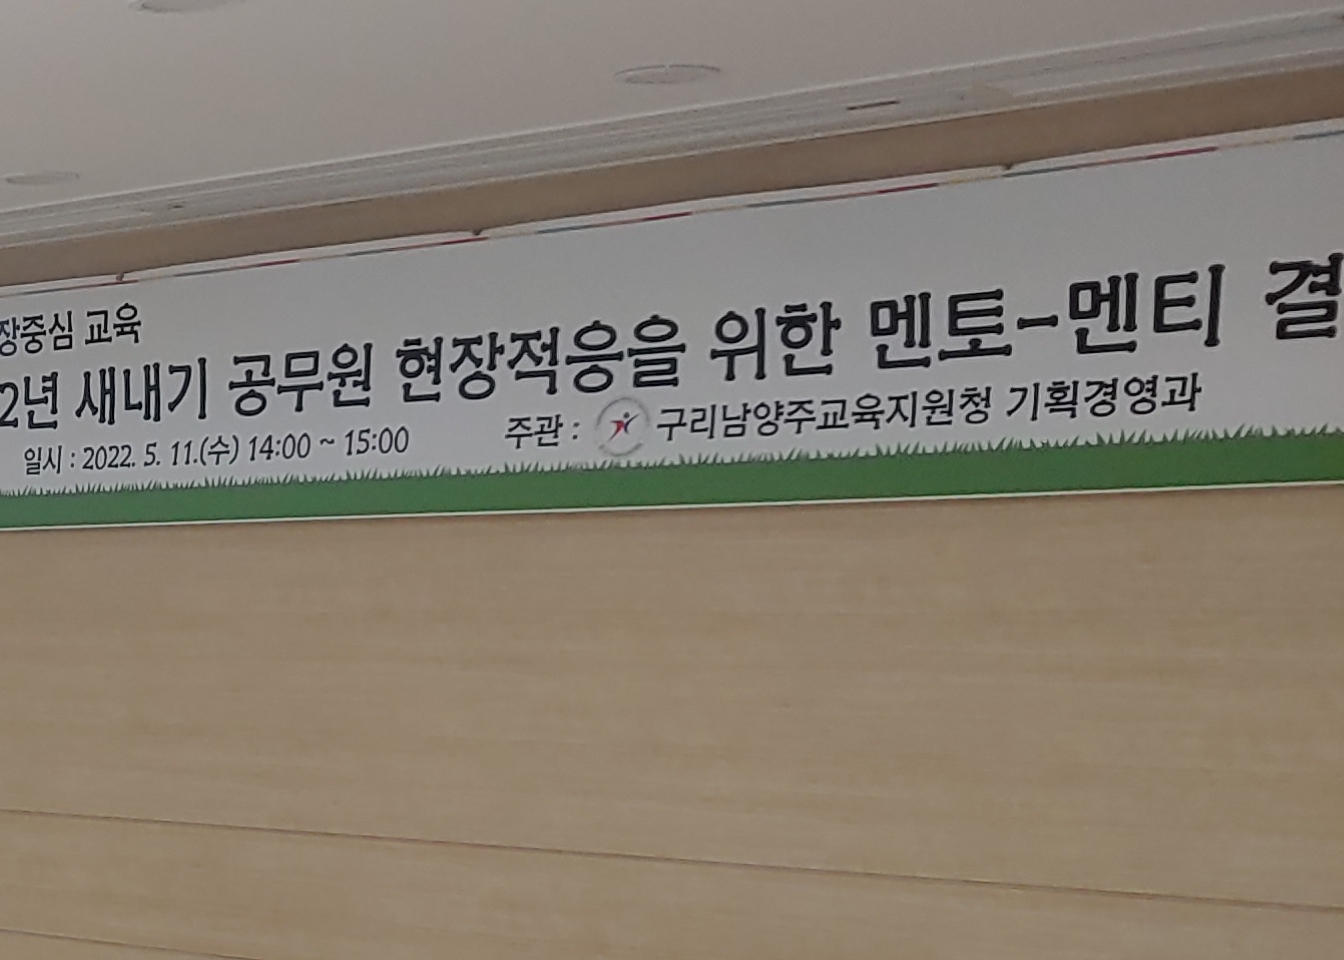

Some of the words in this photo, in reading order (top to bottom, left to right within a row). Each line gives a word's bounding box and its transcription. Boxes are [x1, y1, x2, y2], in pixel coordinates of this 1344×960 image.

[75, 357, 207, 425] 새내기
[228, 343, 374, 416] 공무원
[396, 315, 687, 402] 현장적응을
[710, 301, 841, 382] 위한
[869, 264, 1225, 369] 멘토-멘티
[1265, 253, 1344, 340] 결
[84, 303, 142, 346] 교육
[505, 414, 563, 449] 주관
[657, 385, 992, 441] 구리남양주교육지원청
[1007, 372, 1202, 421] 기획경영과
[24, 446, 63, 475] 일시
[83, 445, 136, 471] 2022.
[144, 441, 161, 466] 5.
[171, 434, 239, 467] 11.(수)
[248, 432, 311, 461] 14:00
[345, 426, 410, 456] 15:00
